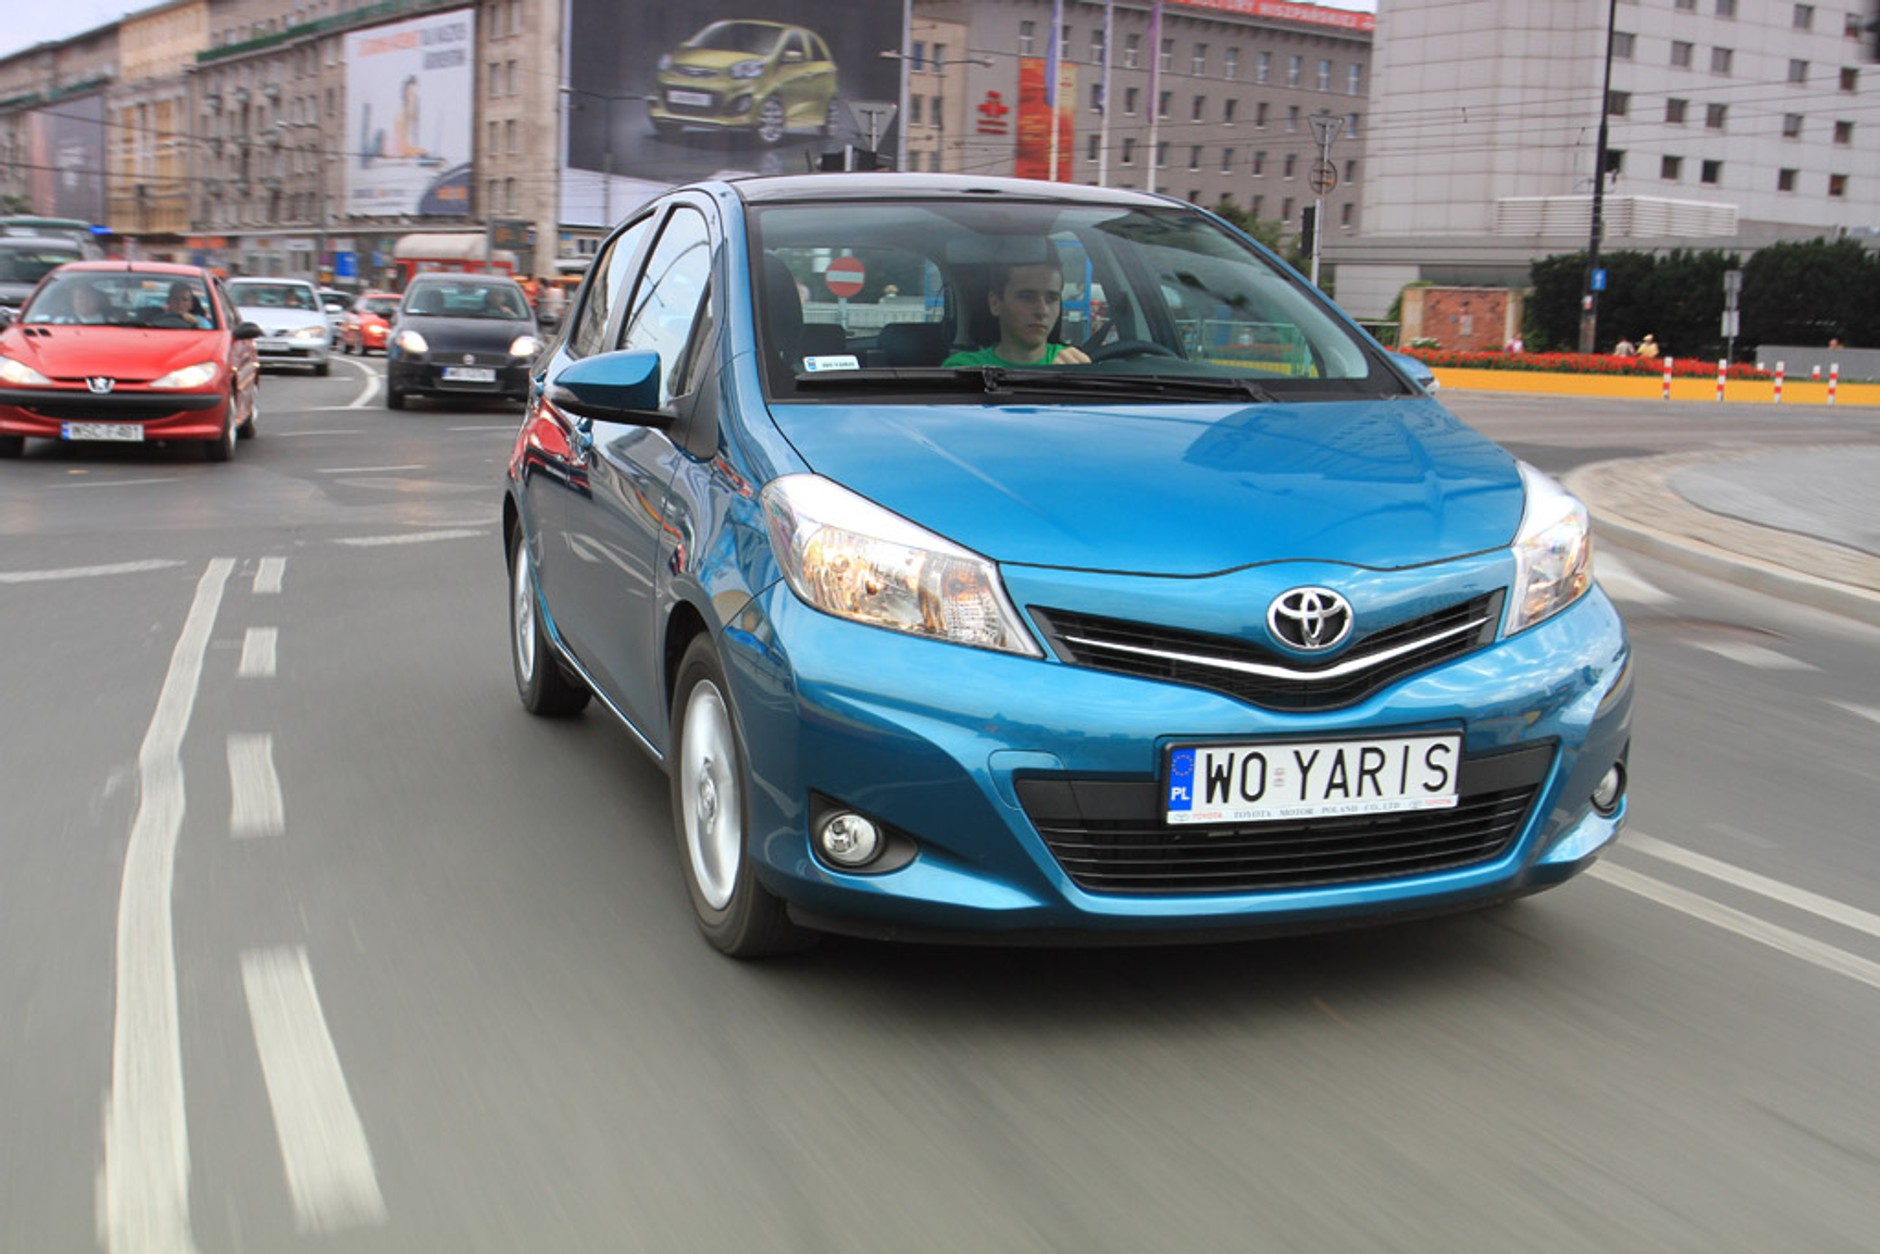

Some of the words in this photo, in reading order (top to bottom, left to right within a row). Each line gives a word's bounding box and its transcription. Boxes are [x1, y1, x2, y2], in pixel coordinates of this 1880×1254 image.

[1205, 751, 1267, 804] WO
[1293, 743, 1452, 801] YARIS
[1170, 786, 1190, 801] PL
[1233, 809, 1272, 819] TOYOTA
[1279, 807, 1314, 816] MOTOR
[1321, 804, 1359, 814] POLAND
